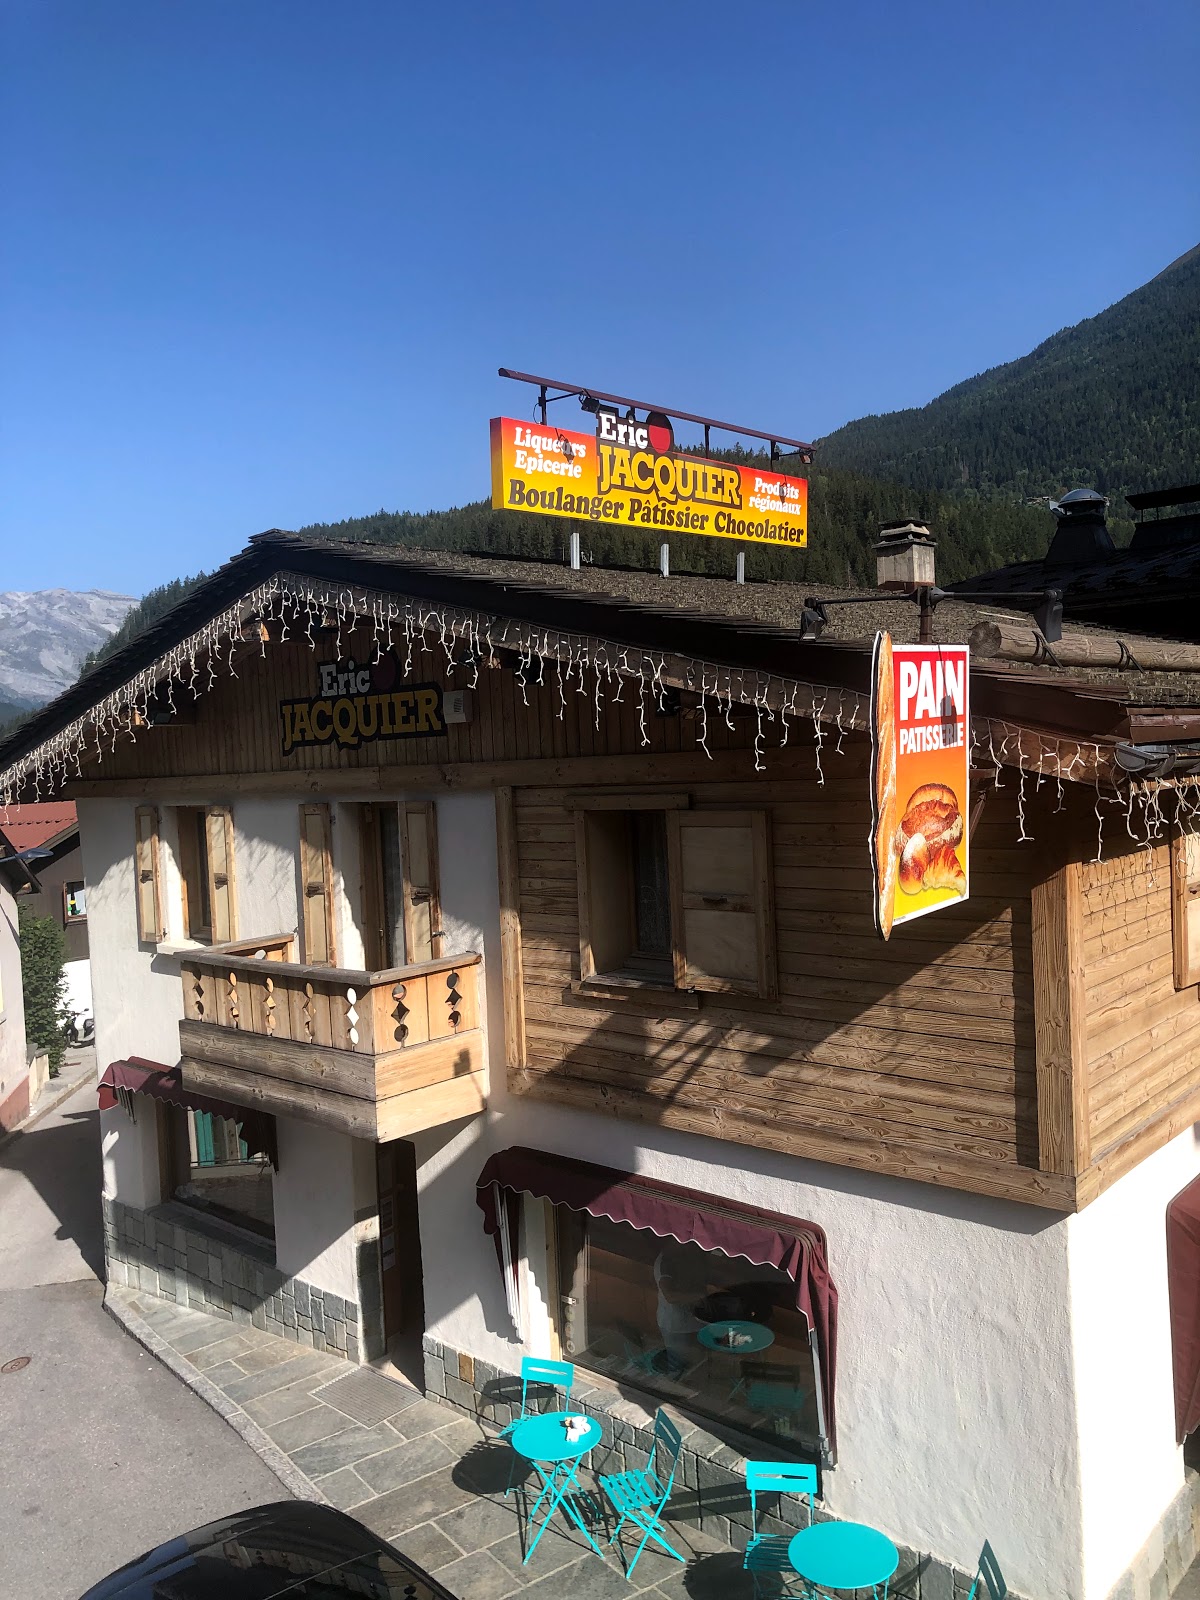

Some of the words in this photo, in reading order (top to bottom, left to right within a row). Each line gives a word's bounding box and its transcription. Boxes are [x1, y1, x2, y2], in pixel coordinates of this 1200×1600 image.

[514, 427, 586, 458] Liqueurs
[599, 410, 648, 449] Eric
[514, 450, 582, 478] Epicerie
[600, 445, 740, 505] JACQUIER
[749, 494, 801, 515] régionaux
[754, 477, 799, 499] Produits
[508, 479, 624, 520] Boulanger
[628, 498, 709, 530] Pâtissier
[714, 511, 804, 542] Chocolatier
[320, 660, 370, 697] Eric
[900, 660, 964, 721] PAIN
[282, 689, 442, 750] JACQUIER
[900, 722, 964, 755] PATISSERIE
